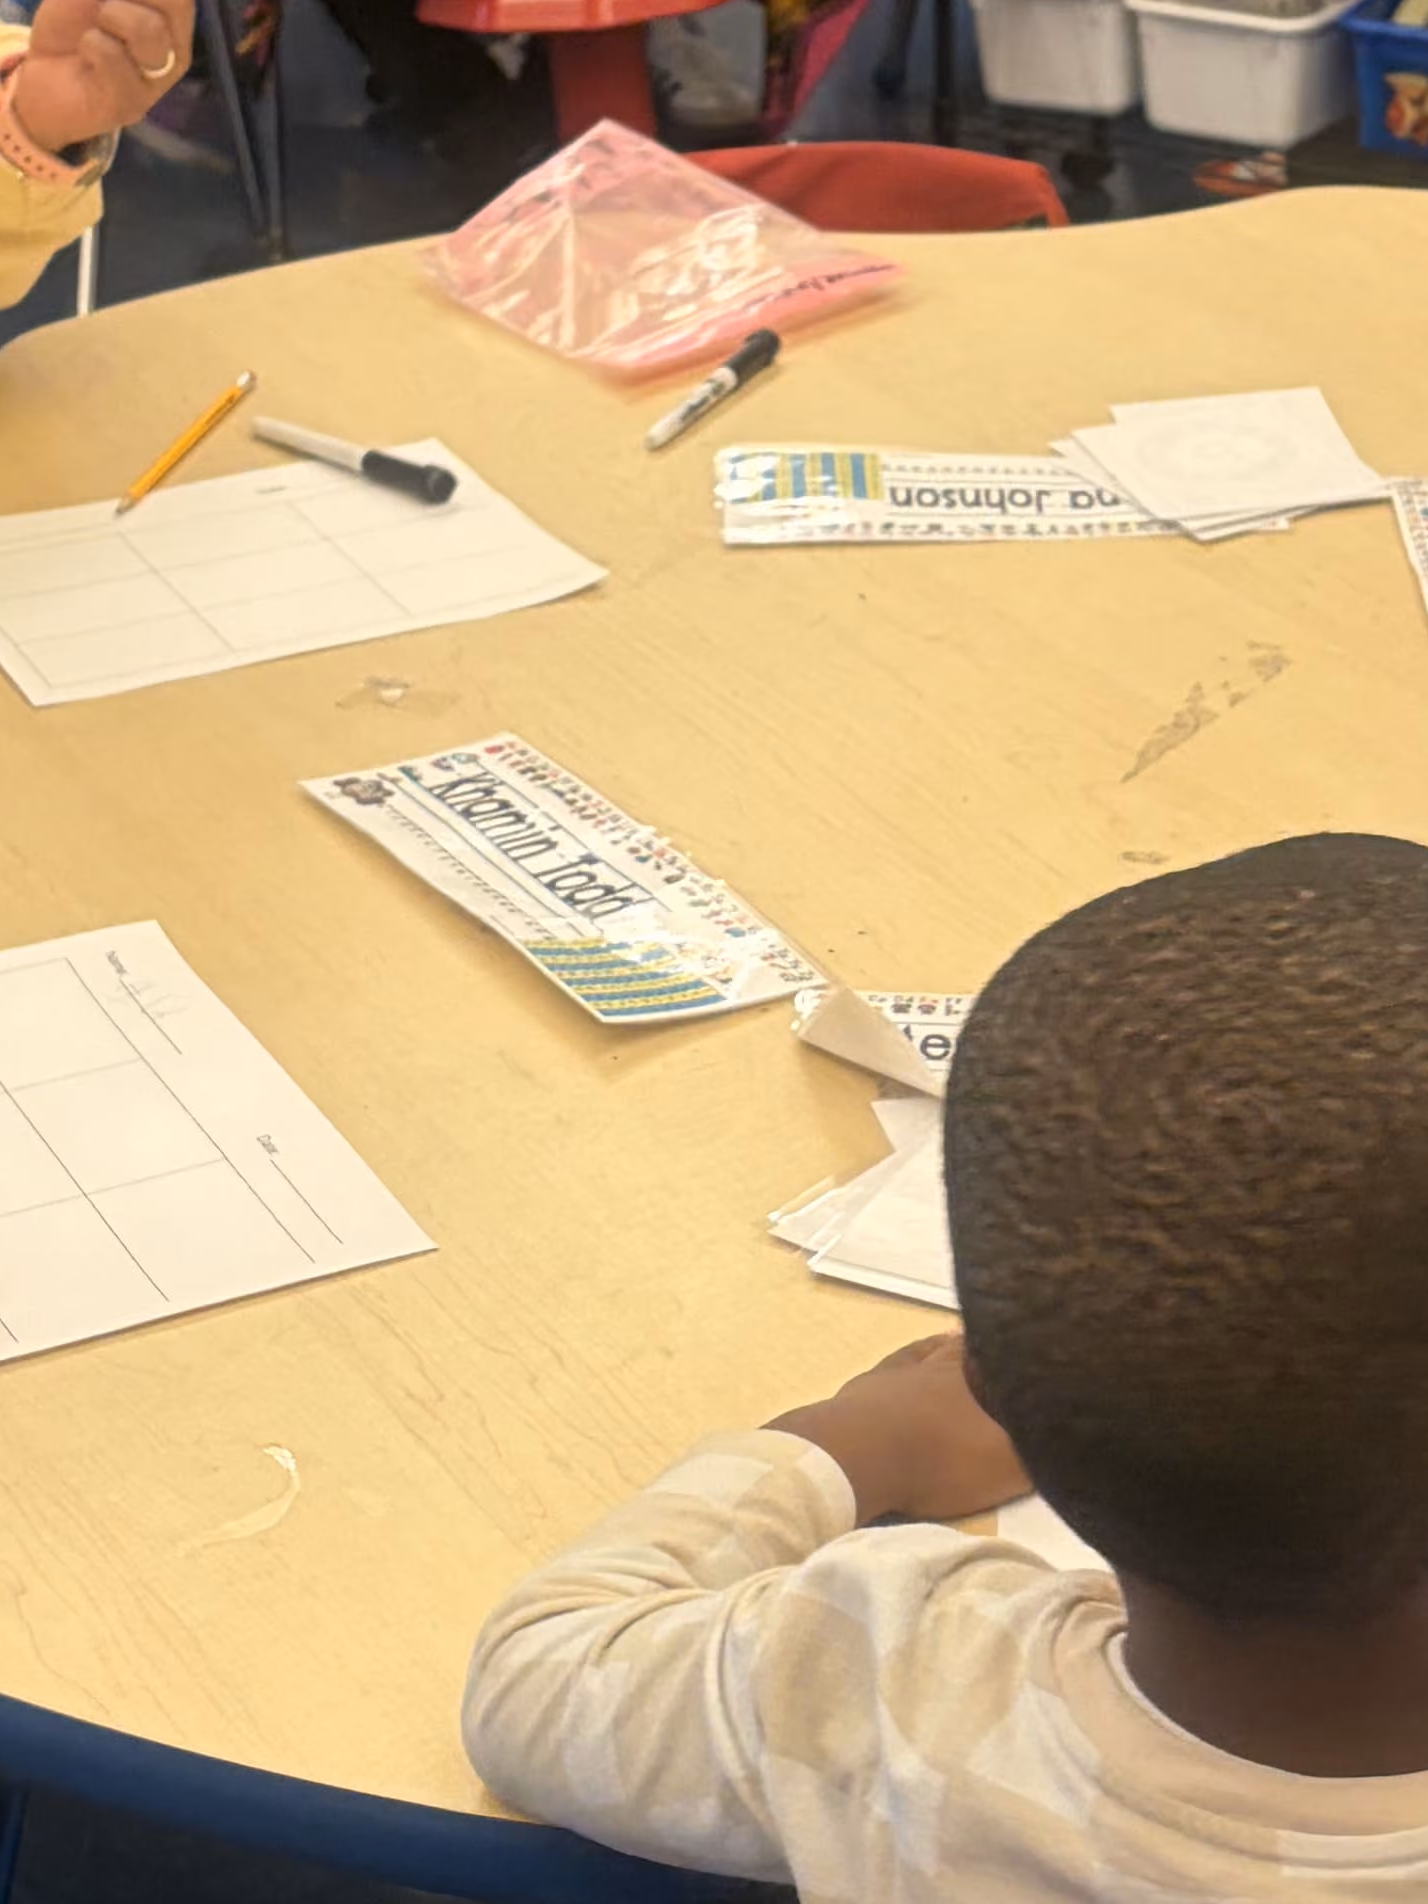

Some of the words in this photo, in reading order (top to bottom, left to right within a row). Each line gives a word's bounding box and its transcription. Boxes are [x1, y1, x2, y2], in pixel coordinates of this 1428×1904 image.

[888, 483, 1048, 515] Johnson
[427, 770, 558, 863] Khamin
[534, 851, 656, 919] Todd
